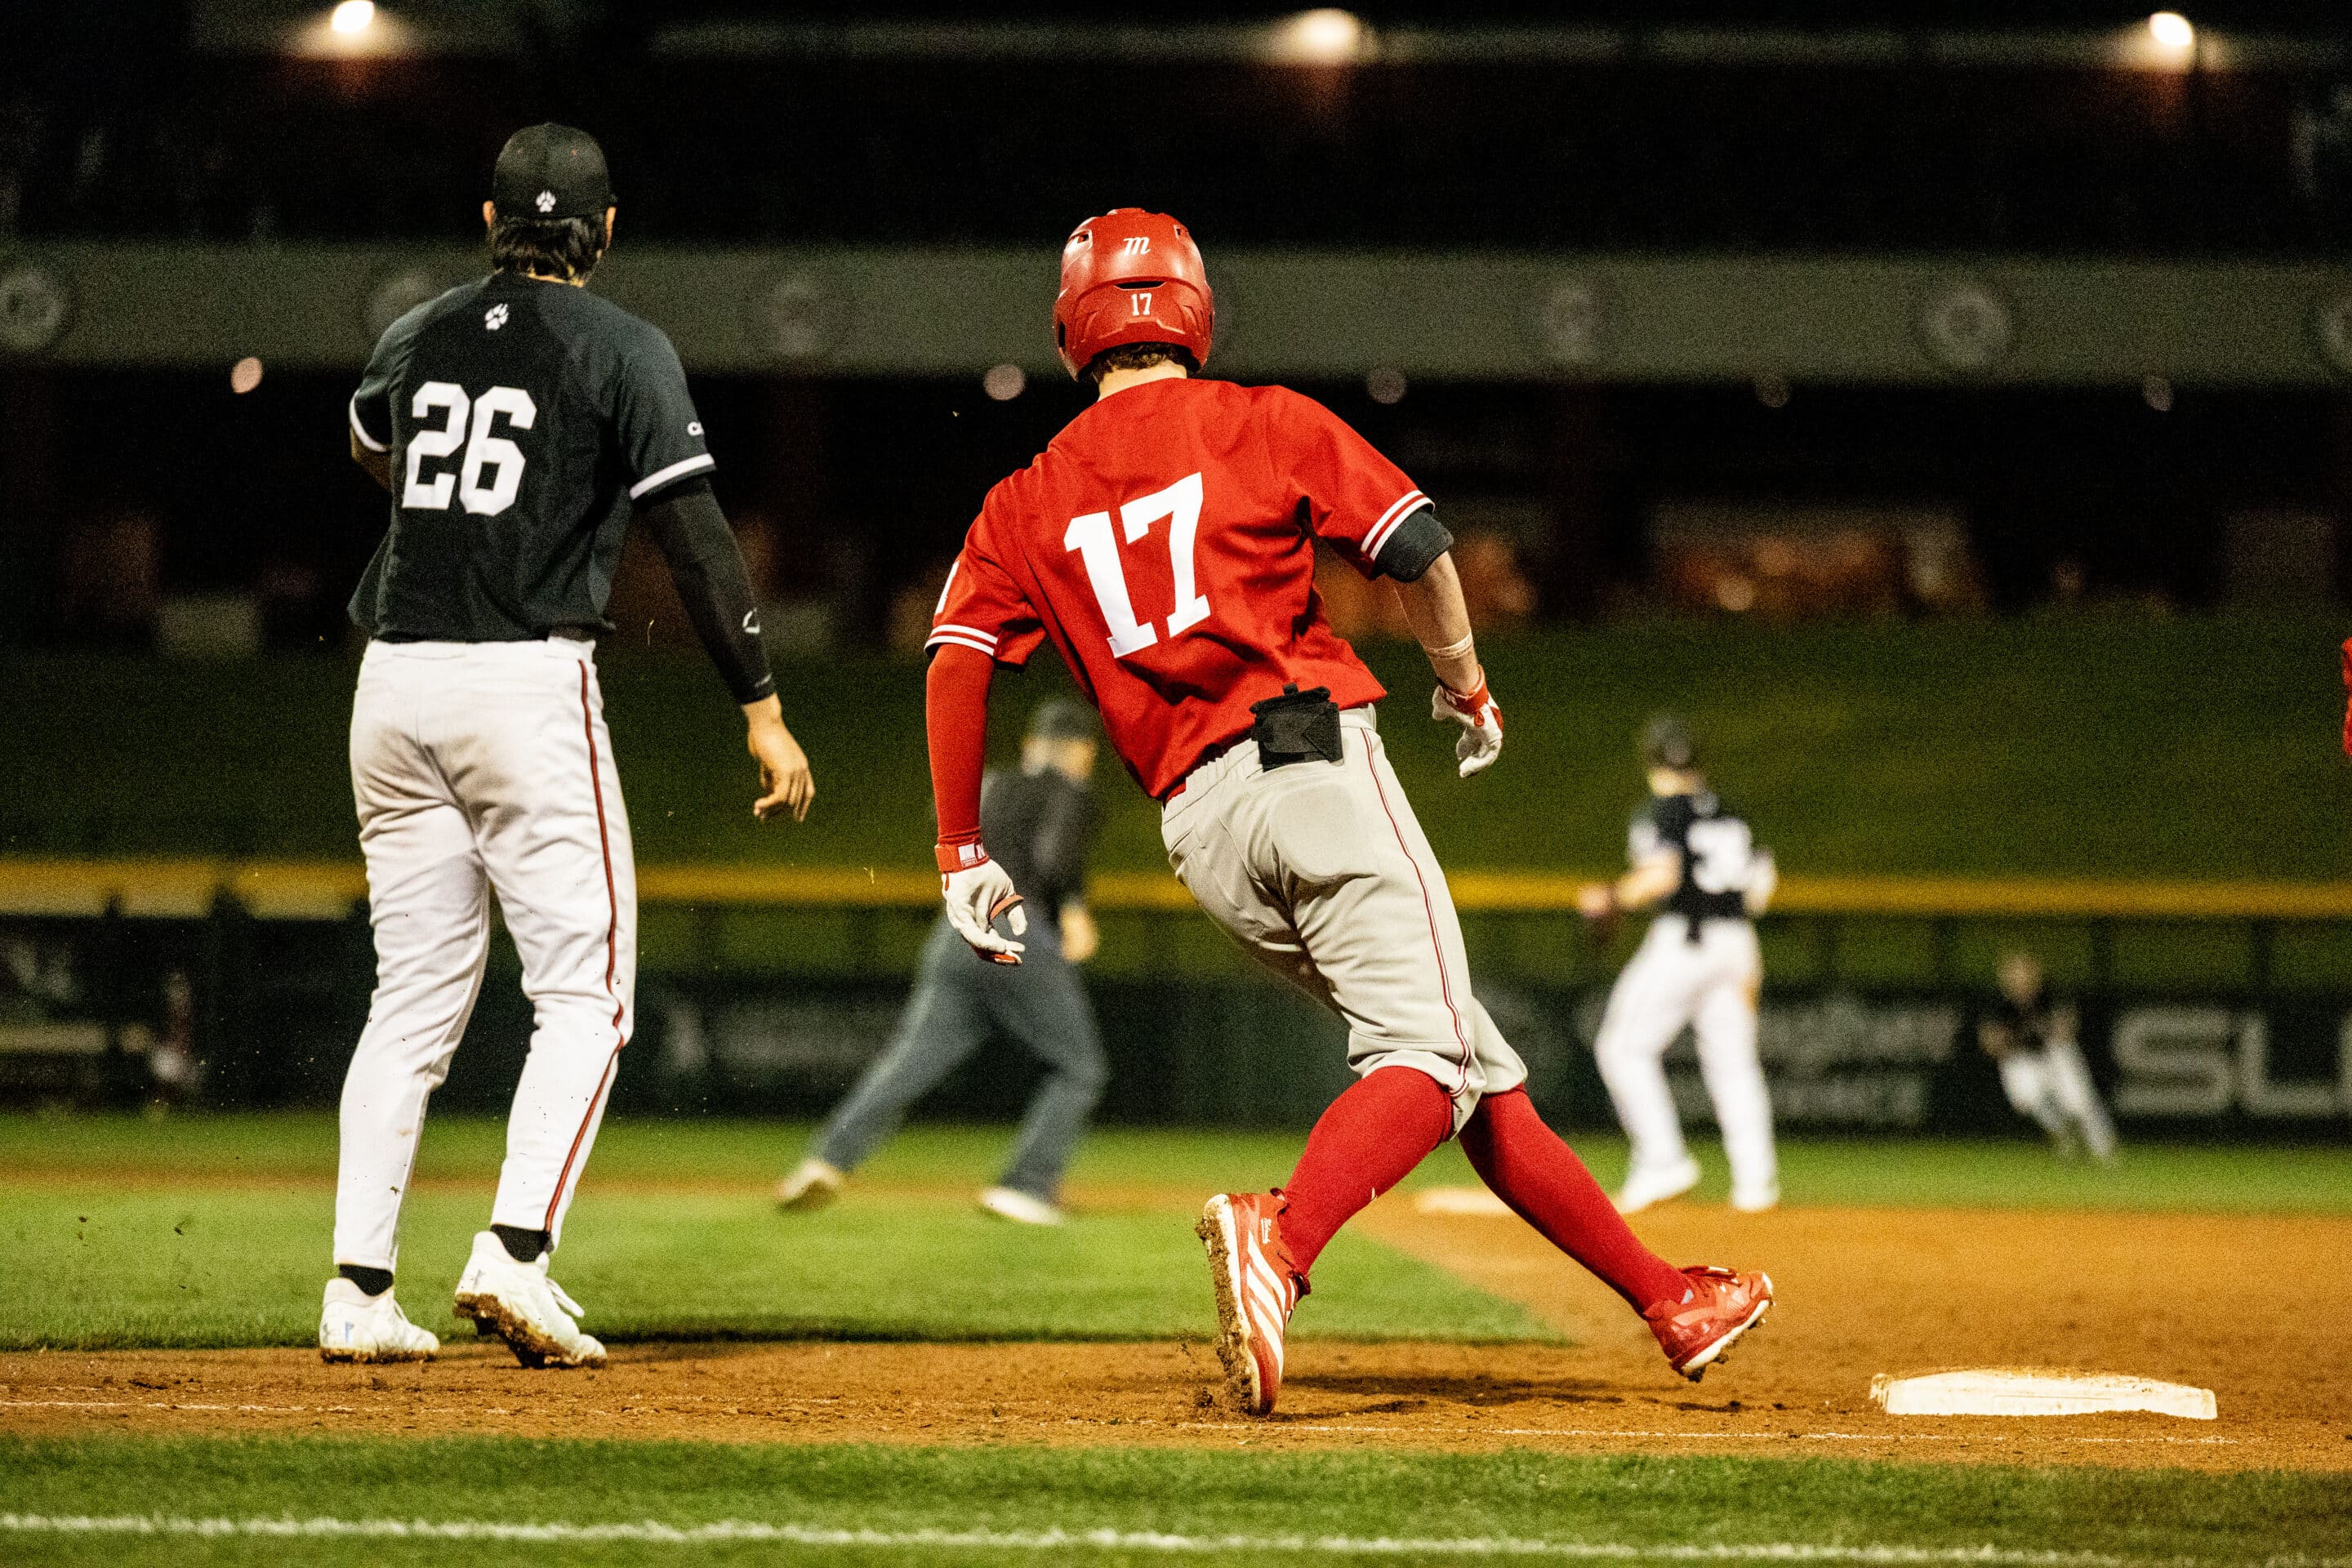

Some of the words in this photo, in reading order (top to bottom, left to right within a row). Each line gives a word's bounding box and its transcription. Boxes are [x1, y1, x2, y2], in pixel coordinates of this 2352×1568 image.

[1131, 292, 1152, 316] 17
[402, 381, 537, 516] 26
[1063, 471, 1211, 659] 17
